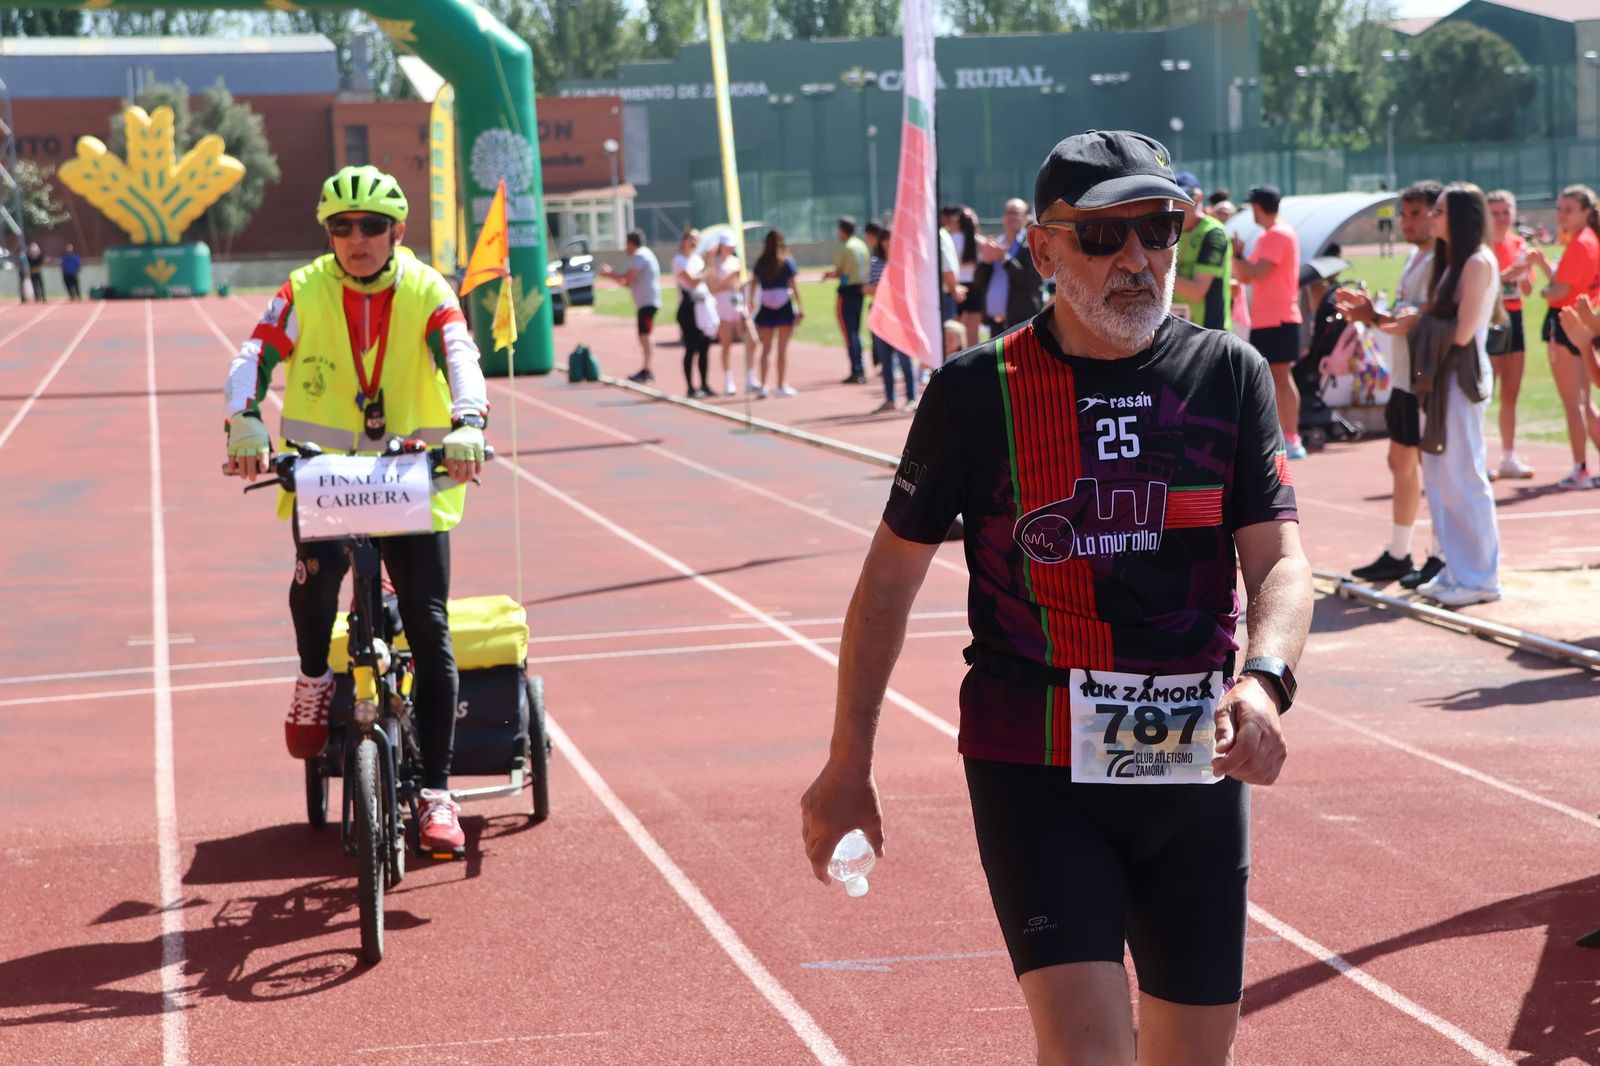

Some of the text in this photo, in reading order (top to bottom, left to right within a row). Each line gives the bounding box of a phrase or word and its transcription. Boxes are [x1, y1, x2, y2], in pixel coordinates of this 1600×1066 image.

[955, 65, 1054, 89] RURAL
[677, 83, 699, 99] DE
[1109, 391, 1152, 409] rasán
[1095, 415, 1141, 461] 25
[318, 473, 377, 488] FINAL
[316, 489, 411, 509] CARRERA
[1076, 529, 1158, 556] La muralla
[1080, 681, 1215, 703] 10K ZAMORA
[1095, 703, 1204, 745] 787
[1135, 752, 1154, 764] CLUB
[1154, 752, 1193, 764] ATLETISMO
[1135, 764, 1165, 776] ZAMORA
